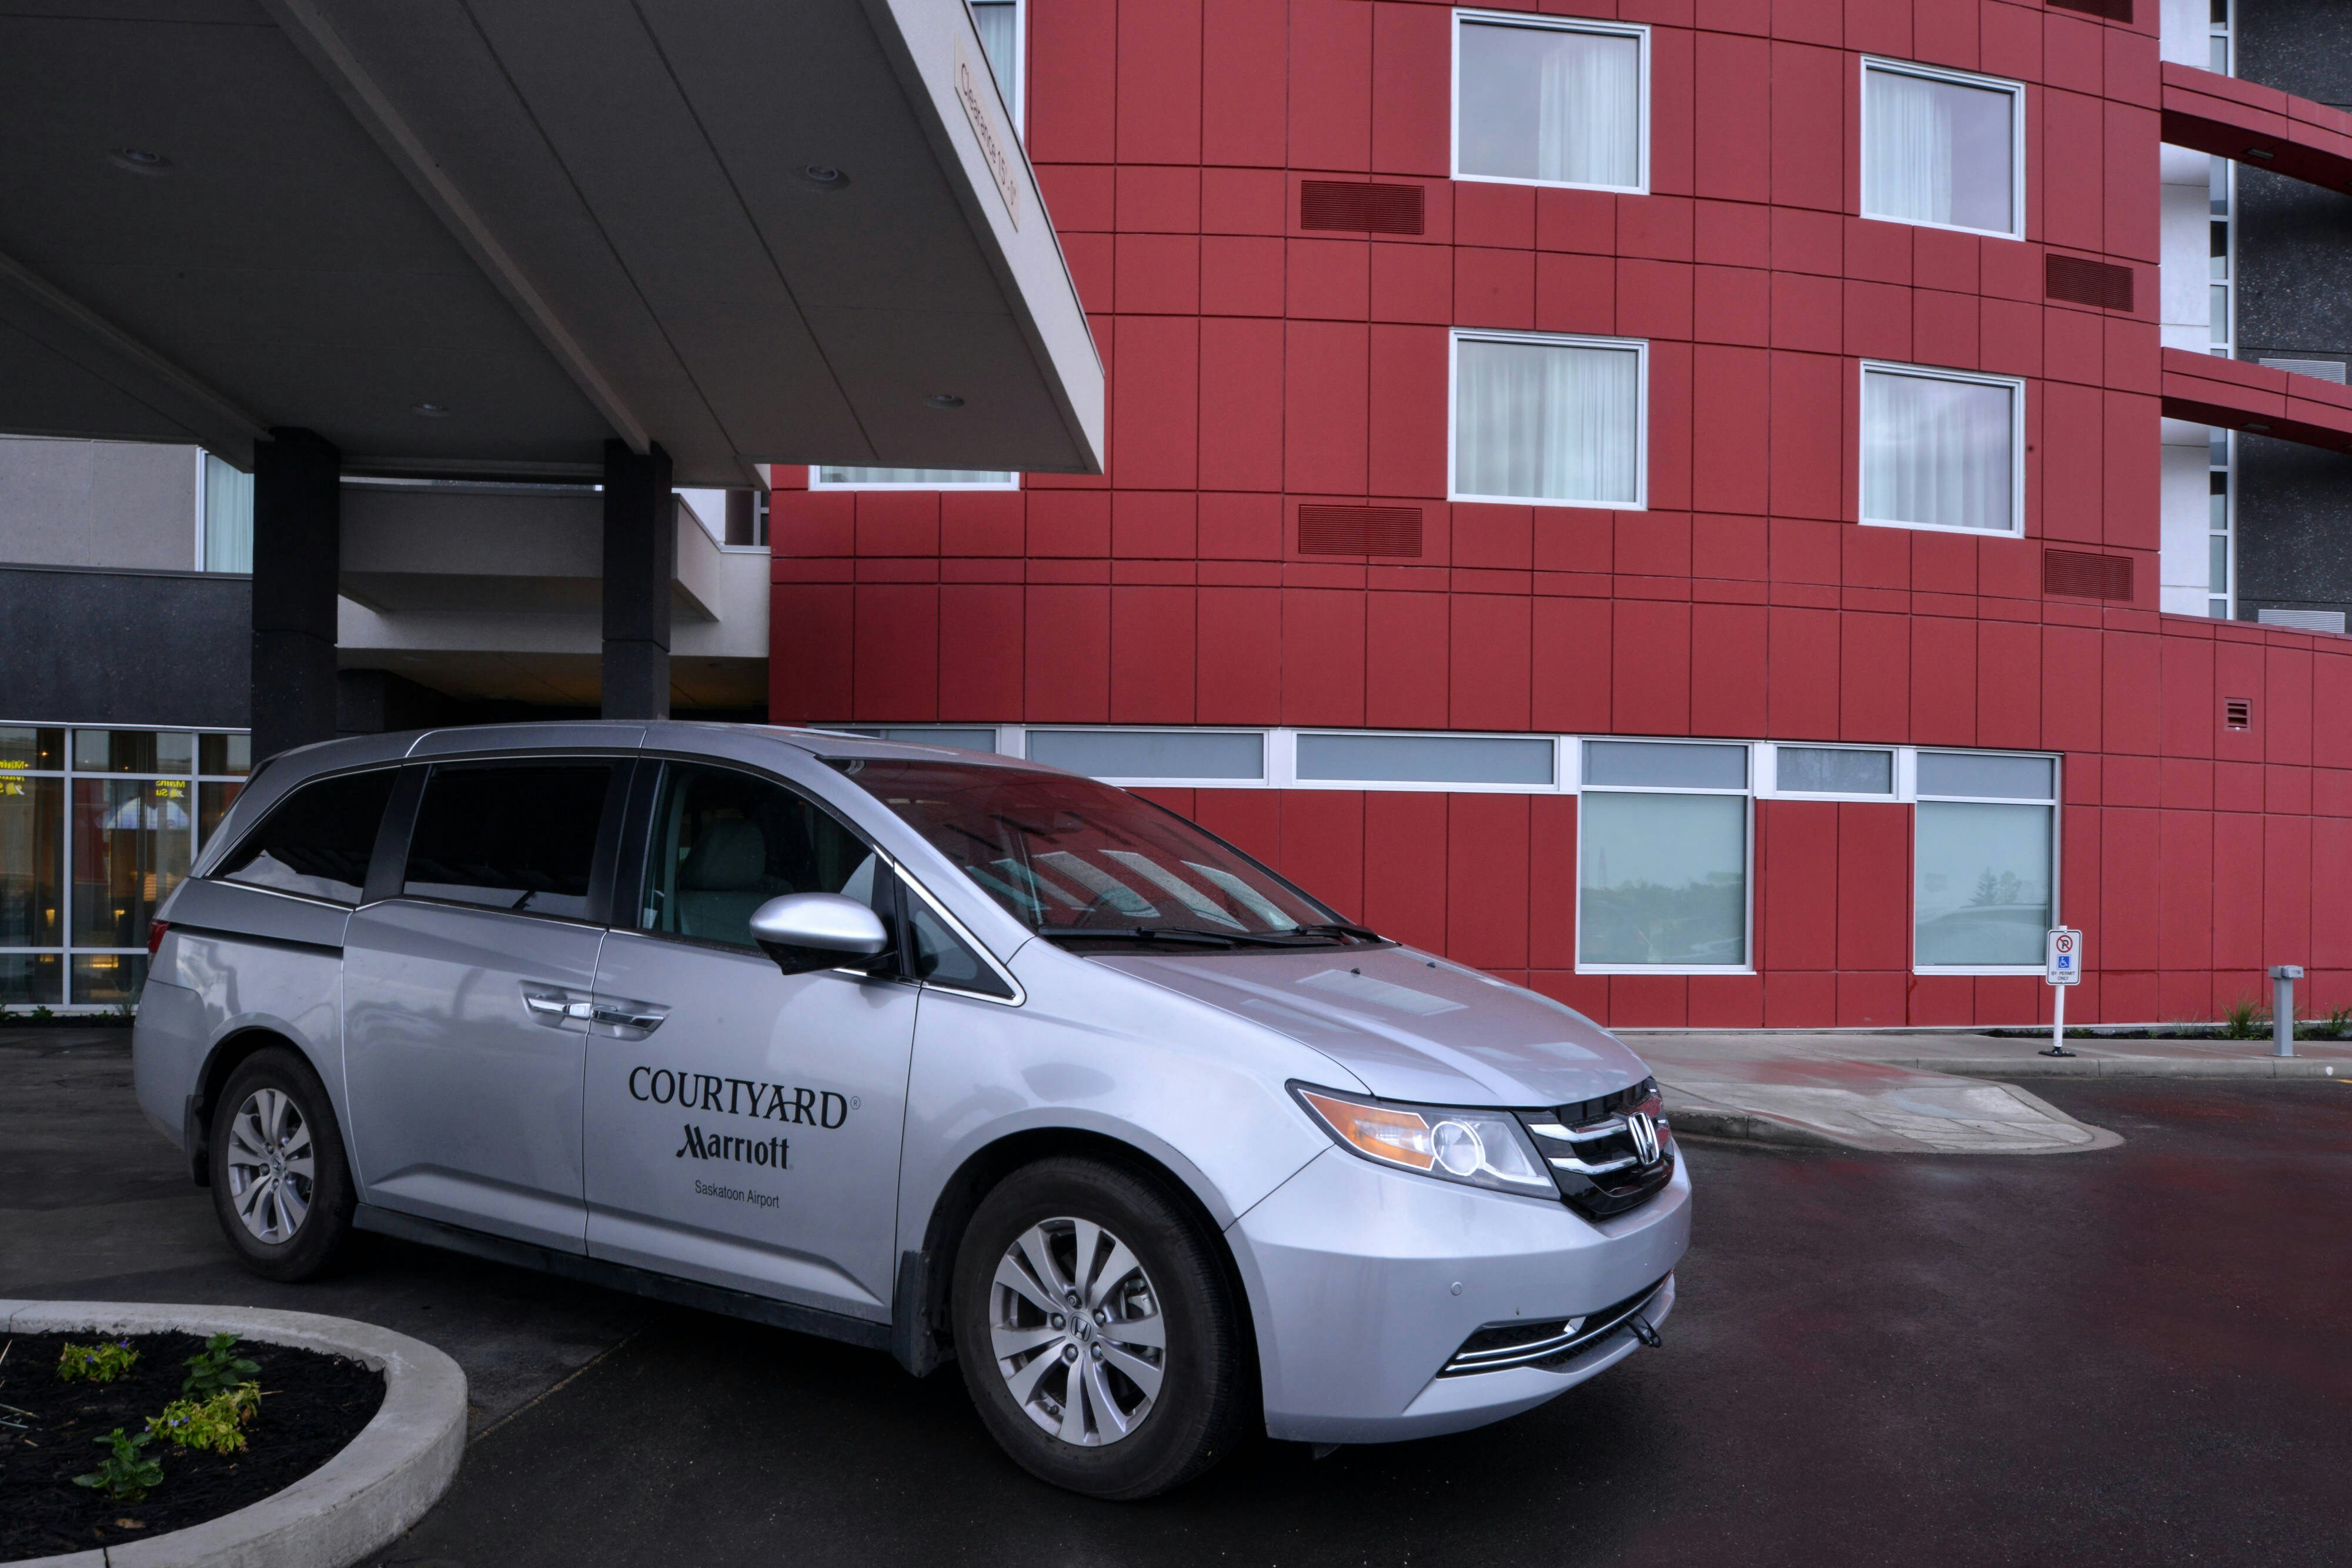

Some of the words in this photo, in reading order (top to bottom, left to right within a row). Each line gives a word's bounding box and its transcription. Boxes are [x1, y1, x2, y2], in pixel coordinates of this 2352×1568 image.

[961, 62, 996, 164] Clearance
[629, 1066, 848, 1129] COURTYARD
[676, 1124, 790, 1170] Marriott
[694, 1179, 744, 1202] Saskatoon
[747, 1189, 780, 1209] Airport
